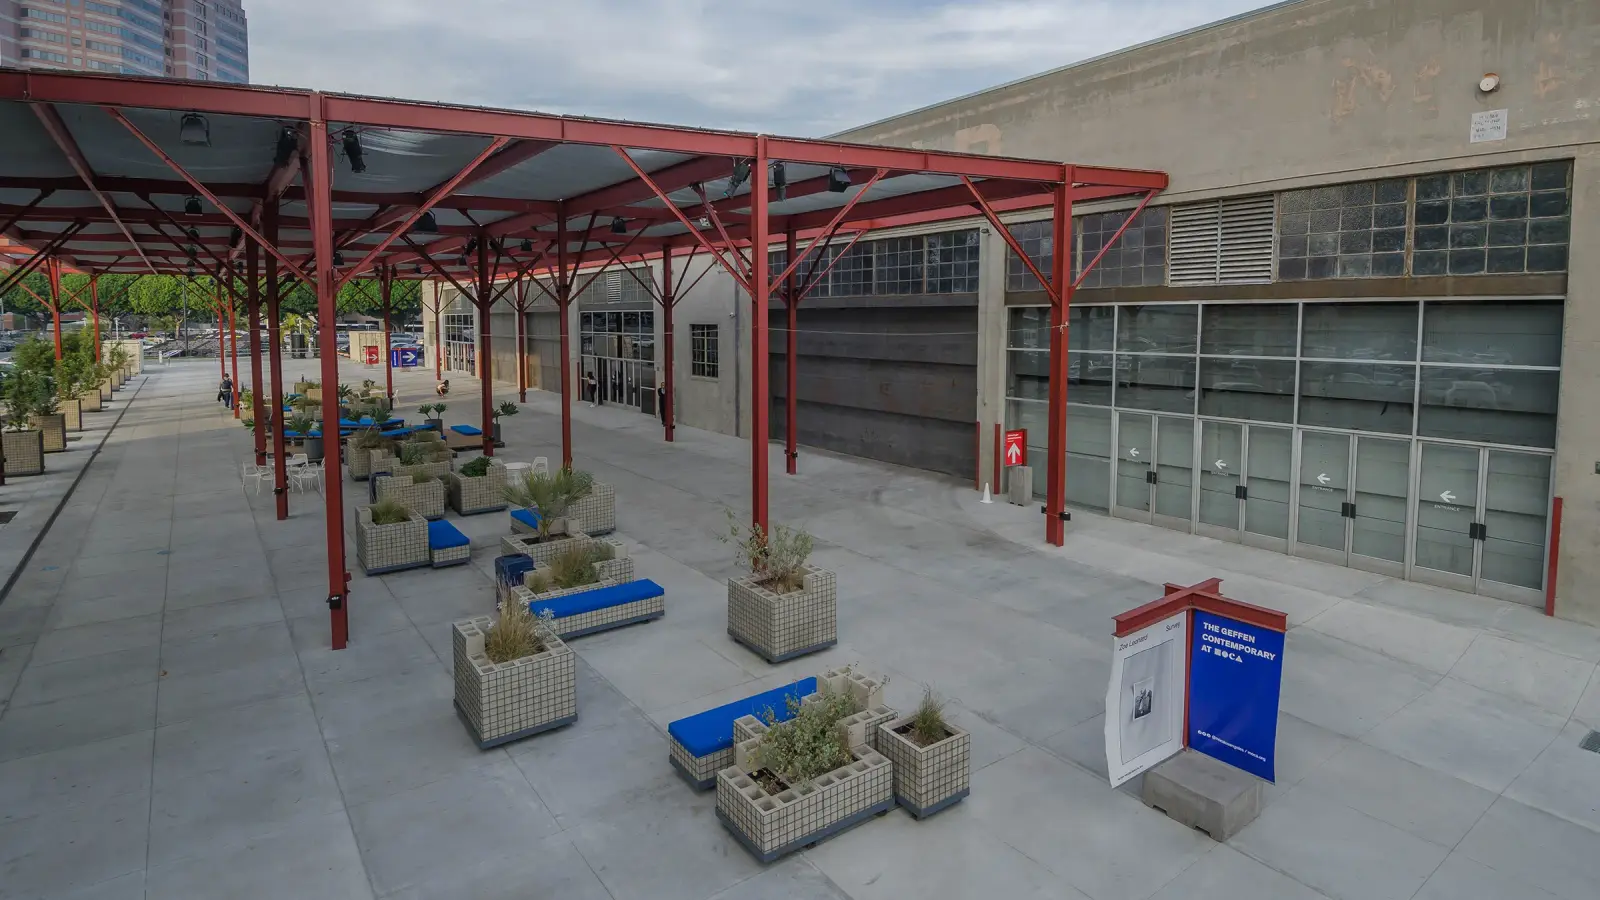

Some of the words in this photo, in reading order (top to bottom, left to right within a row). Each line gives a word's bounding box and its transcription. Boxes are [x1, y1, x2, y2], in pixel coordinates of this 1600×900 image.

[1434, 504, 1460, 512] ENTRANCE
[1165, 622, 1181, 632] Survey
[1203, 621, 1220, 633] THE
[1220, 627, 1256, 644] GEFFEN
[1129, 633, 1149, 648] Leonard
[1201, 644, 1213, 653] AT
[1202, 633, 1276, 661] CONTEMPORARY
